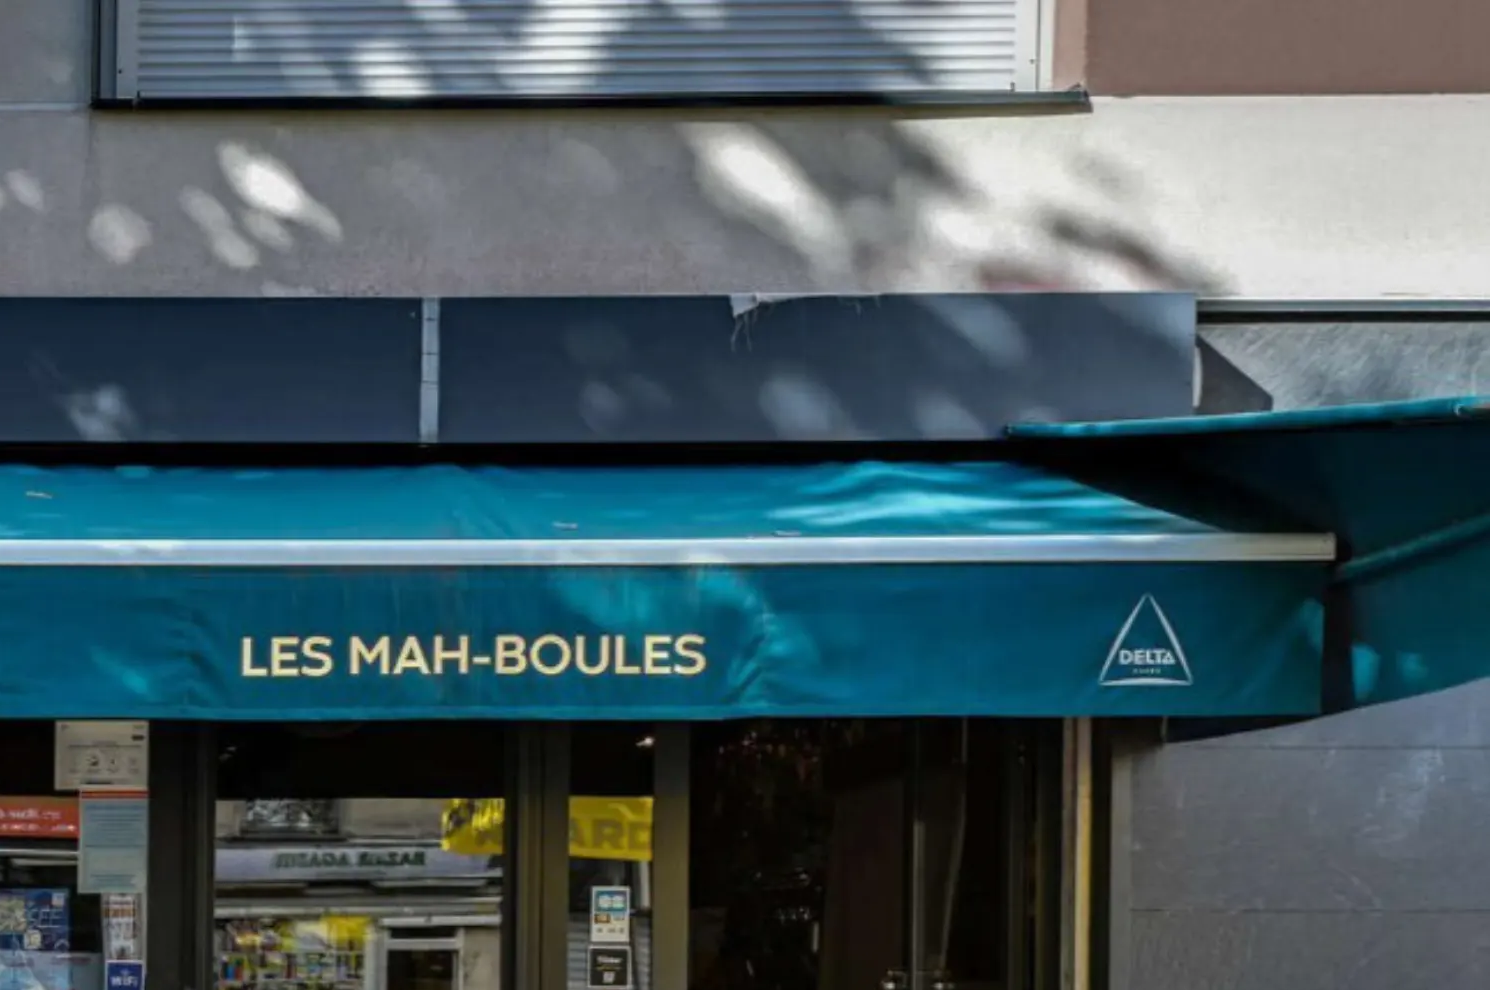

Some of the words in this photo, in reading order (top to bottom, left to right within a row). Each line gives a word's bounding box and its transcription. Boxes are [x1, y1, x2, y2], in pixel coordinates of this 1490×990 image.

[241, 635, 333, 677] LES
[349, 634, 707, 676] MAH-BOULES
[1118, 649, 1176, 665] DELTA
